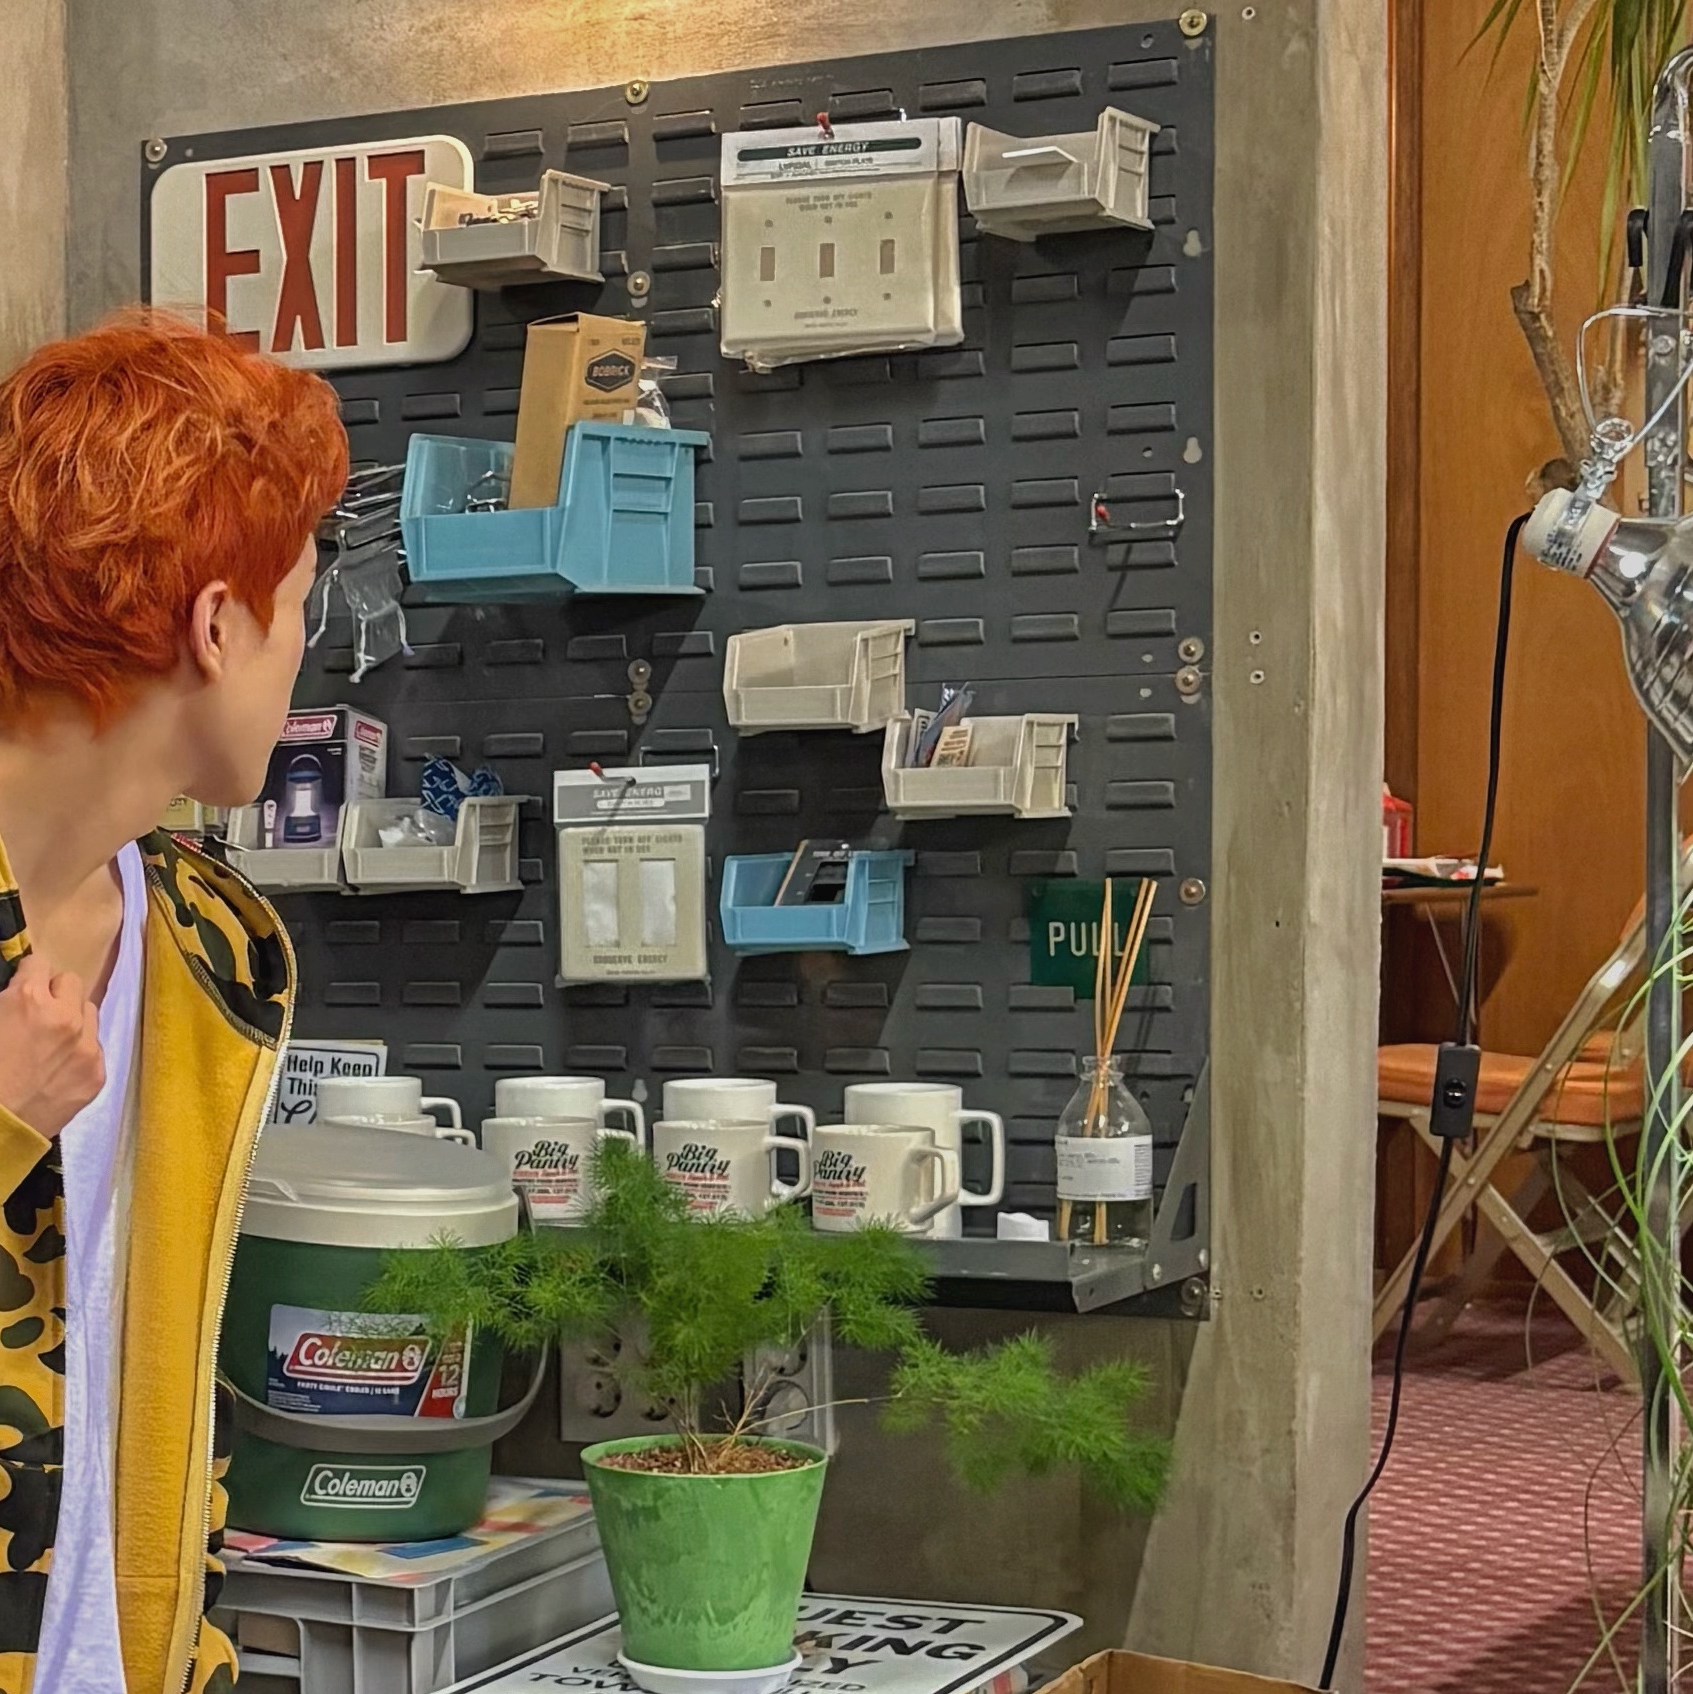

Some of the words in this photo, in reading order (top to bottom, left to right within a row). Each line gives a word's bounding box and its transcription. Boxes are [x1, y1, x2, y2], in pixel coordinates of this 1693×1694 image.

[787, 144, 816, 157] SAVE
[821, 141, 869, 155] ENERGY
[204, 149, 425, 354] EXIT
[626, 787, 662, 798] ENERG
[1048, 920, 1125, 958] PULL
[287, 1054, 324, 1077] Help
[330, 1056, 373, 1077] Keep
[533, 1140, 570, 1159] Big
[680, 1142, 719, 1163] Big
[820, 1150, 853, 1170] Big
[298, 1337, 403, 1371] Coleman
[438, 1363, 460, 1387] 12
[314, 1469, 400, 1498] Coleman
[796, 1605, 987, 1635] UEST
[793, 1630, 987, 1661] KING
[529, 1672, 658, 1694] TOW
